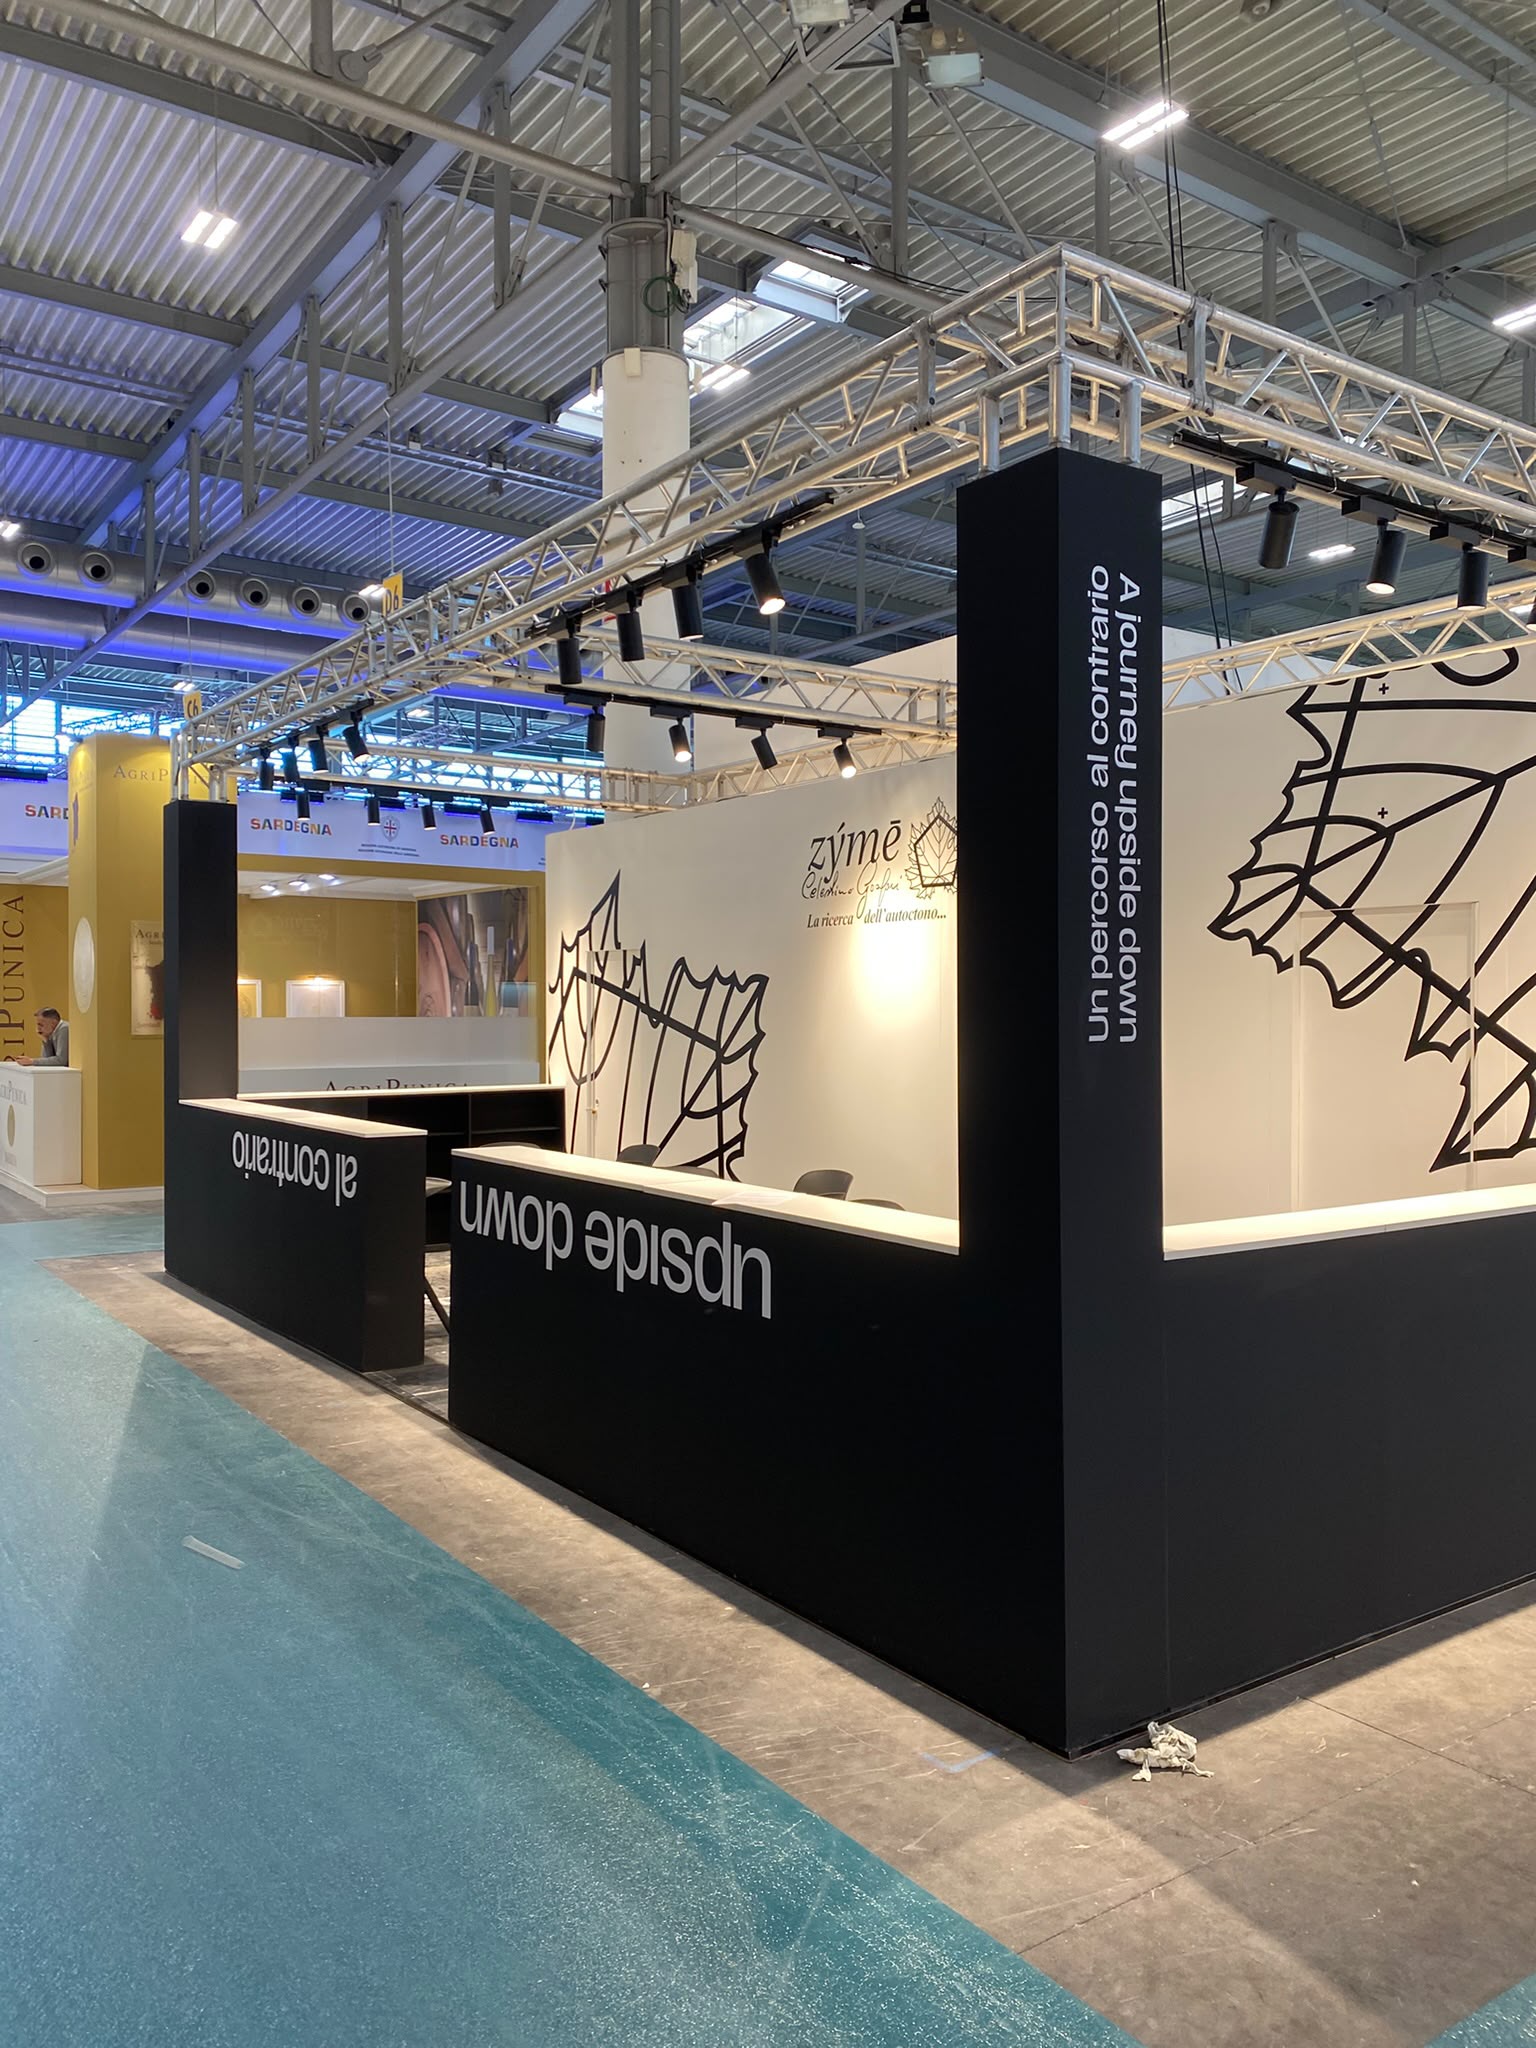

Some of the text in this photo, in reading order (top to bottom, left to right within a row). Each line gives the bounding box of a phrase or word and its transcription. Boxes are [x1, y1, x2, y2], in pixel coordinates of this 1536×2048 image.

[250, 818, 332, 836] SARDEGNA
[1087, 565, 1113, 1042] Un percorso al contrario
[1114, 572, 1142, 1042] A journey upside down
[440, 834, 519, 849] SARDEGNA
[808, 820, 901, 884] zýmē
[807, 914, 820, 928] La
[821, 913, 854, 927] ricerca
[232, 1130, 358, 1207] al contrario
[459, 1180, 772, 1319] upside down
